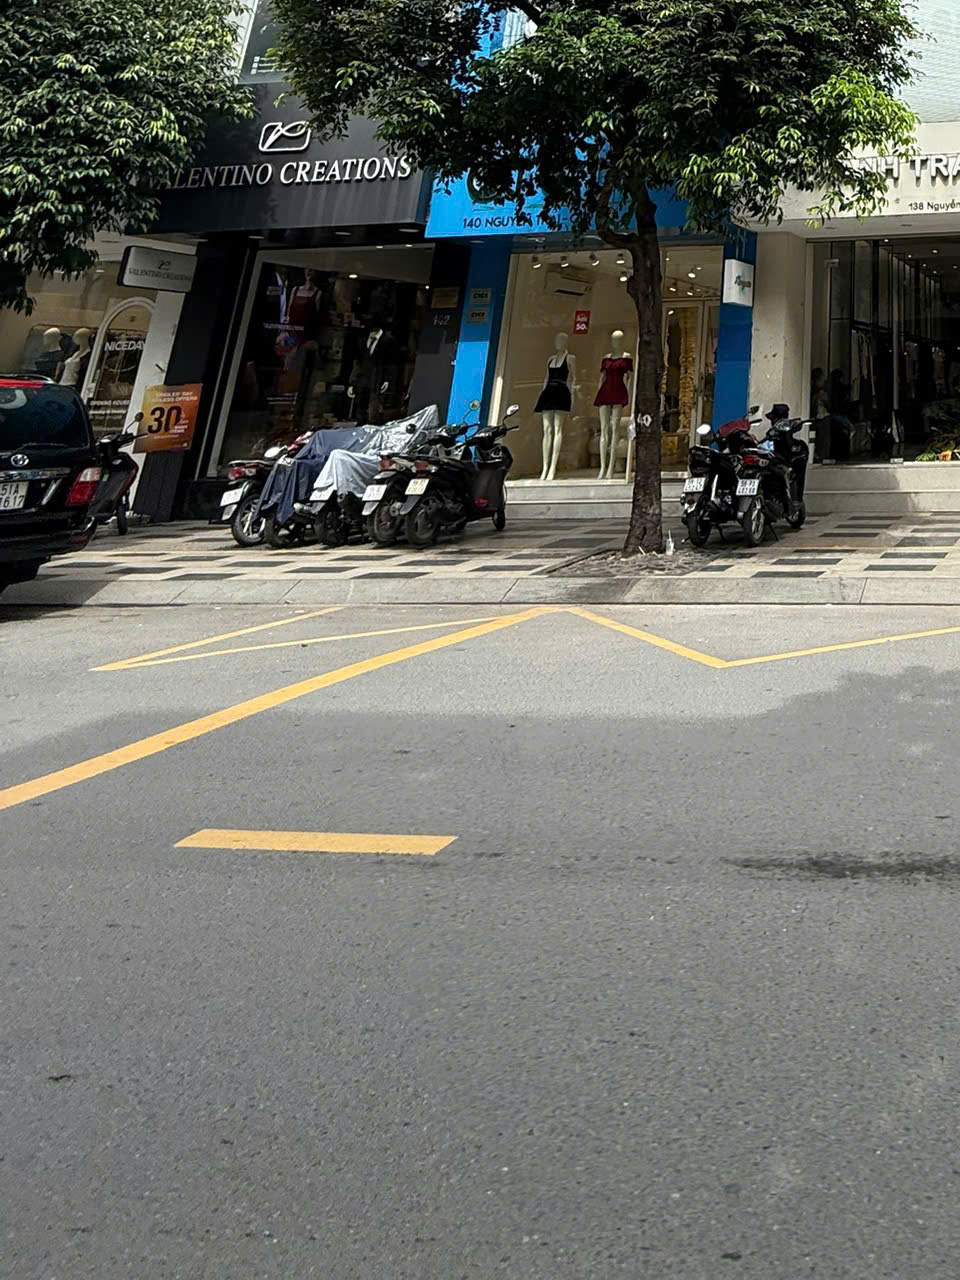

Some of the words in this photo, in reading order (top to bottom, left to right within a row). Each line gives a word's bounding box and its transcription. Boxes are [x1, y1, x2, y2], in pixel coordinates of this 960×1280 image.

[279, 154, 412, 186] CREATIONS
[908, 202, 924, 211] 138
[463, 216, 481, 229] 140
[103, 340, 146, 352] NICEDA
[147, 406, 182, 434] 30
[1, 484, 20, 496] 51A
